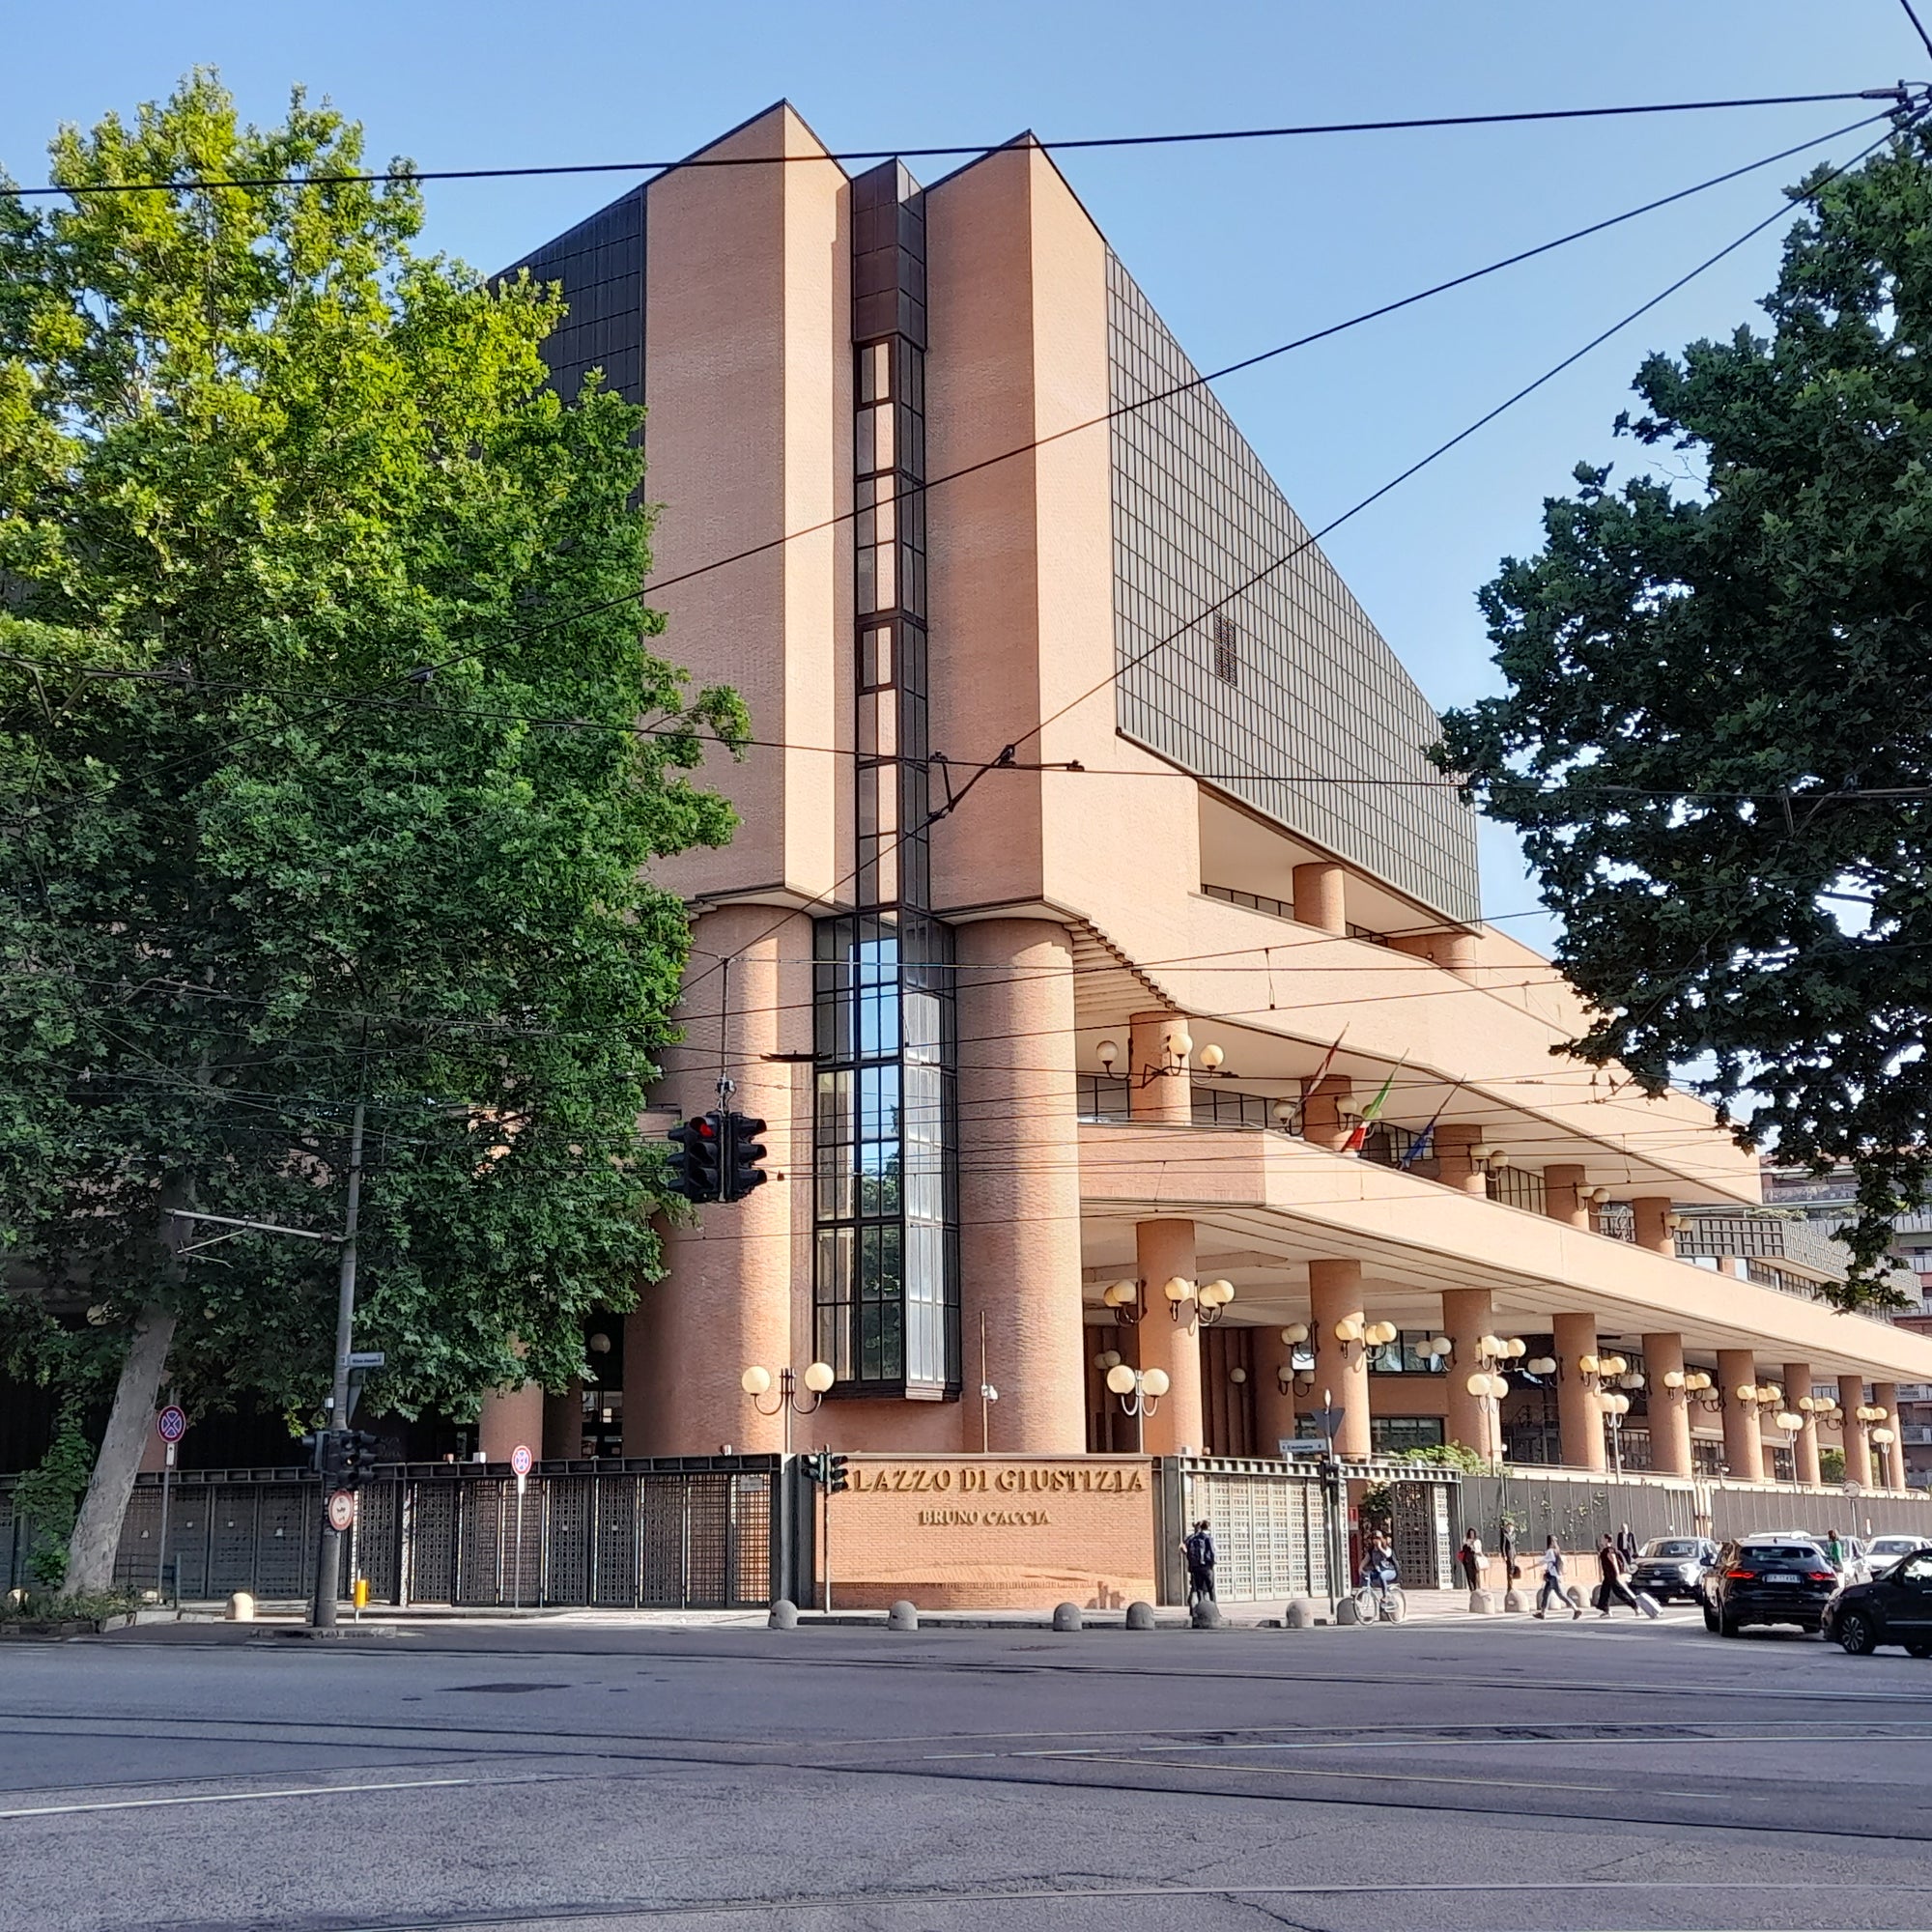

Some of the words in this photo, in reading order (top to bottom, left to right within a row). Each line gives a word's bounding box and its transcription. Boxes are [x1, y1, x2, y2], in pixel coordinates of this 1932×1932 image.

[958, 1468, 988, 1492] DI
[994, 1468, 1147, 1492] GIUSTIZIA
[918, 1509, 980, 1526] BRUNO
[982, 1509, 1051, 1526] CACCIA
